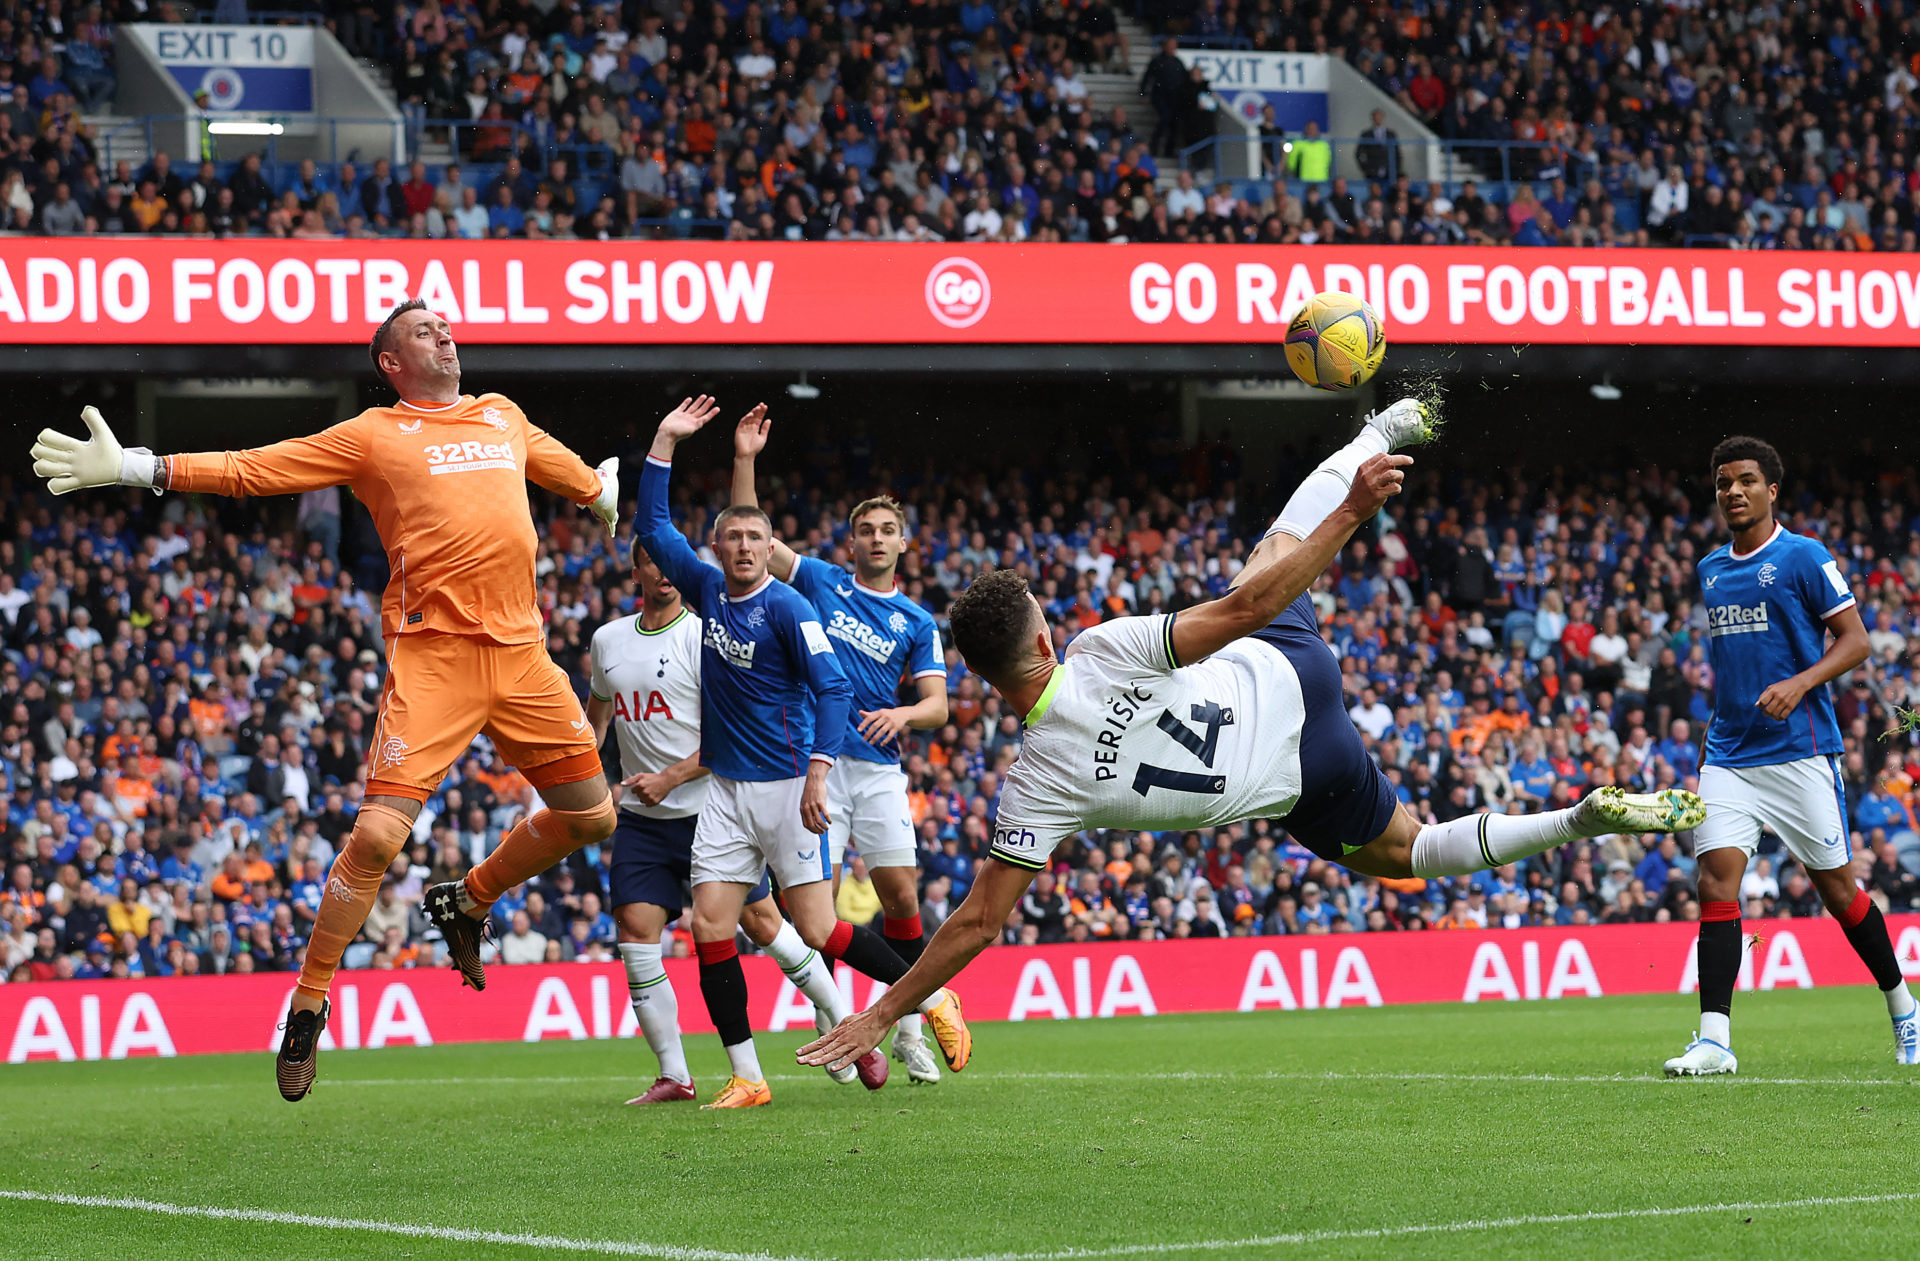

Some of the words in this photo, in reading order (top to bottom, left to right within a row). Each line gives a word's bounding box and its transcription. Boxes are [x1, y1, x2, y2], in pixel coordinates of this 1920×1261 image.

[158, 31, 236, 59] EXIT
[250, 33, 286, 60] 10
[1276, 61, 1304, 85] 11
[172, 258, 549, 324] FOOTBALL
[565, 259, 775, 325] SHOW
[934, 271, 982, 306] Go
[1130, 261, 1218, 325] GO
[1447, 263, 1766, 328] FOOTBALL
[424, 441, 516, 465] 32Red
[830, 610, 898, 657] 32Red
[1708, 601, 1768, 627] 32Red
[614, 690, 674, 722] AIA
[1094, 681, 1153, 782] PERIŠIĆ
[1131, 698, 1235, 798] 14
[1008, 955, 1158, 1022] AIA
[1237, 946, 1384, 1013] AIA
[1462, 938, 1603, 1004] AIA
[8, 992, 178, 1065] AIA
[523, 974, 683, 1043] AI
